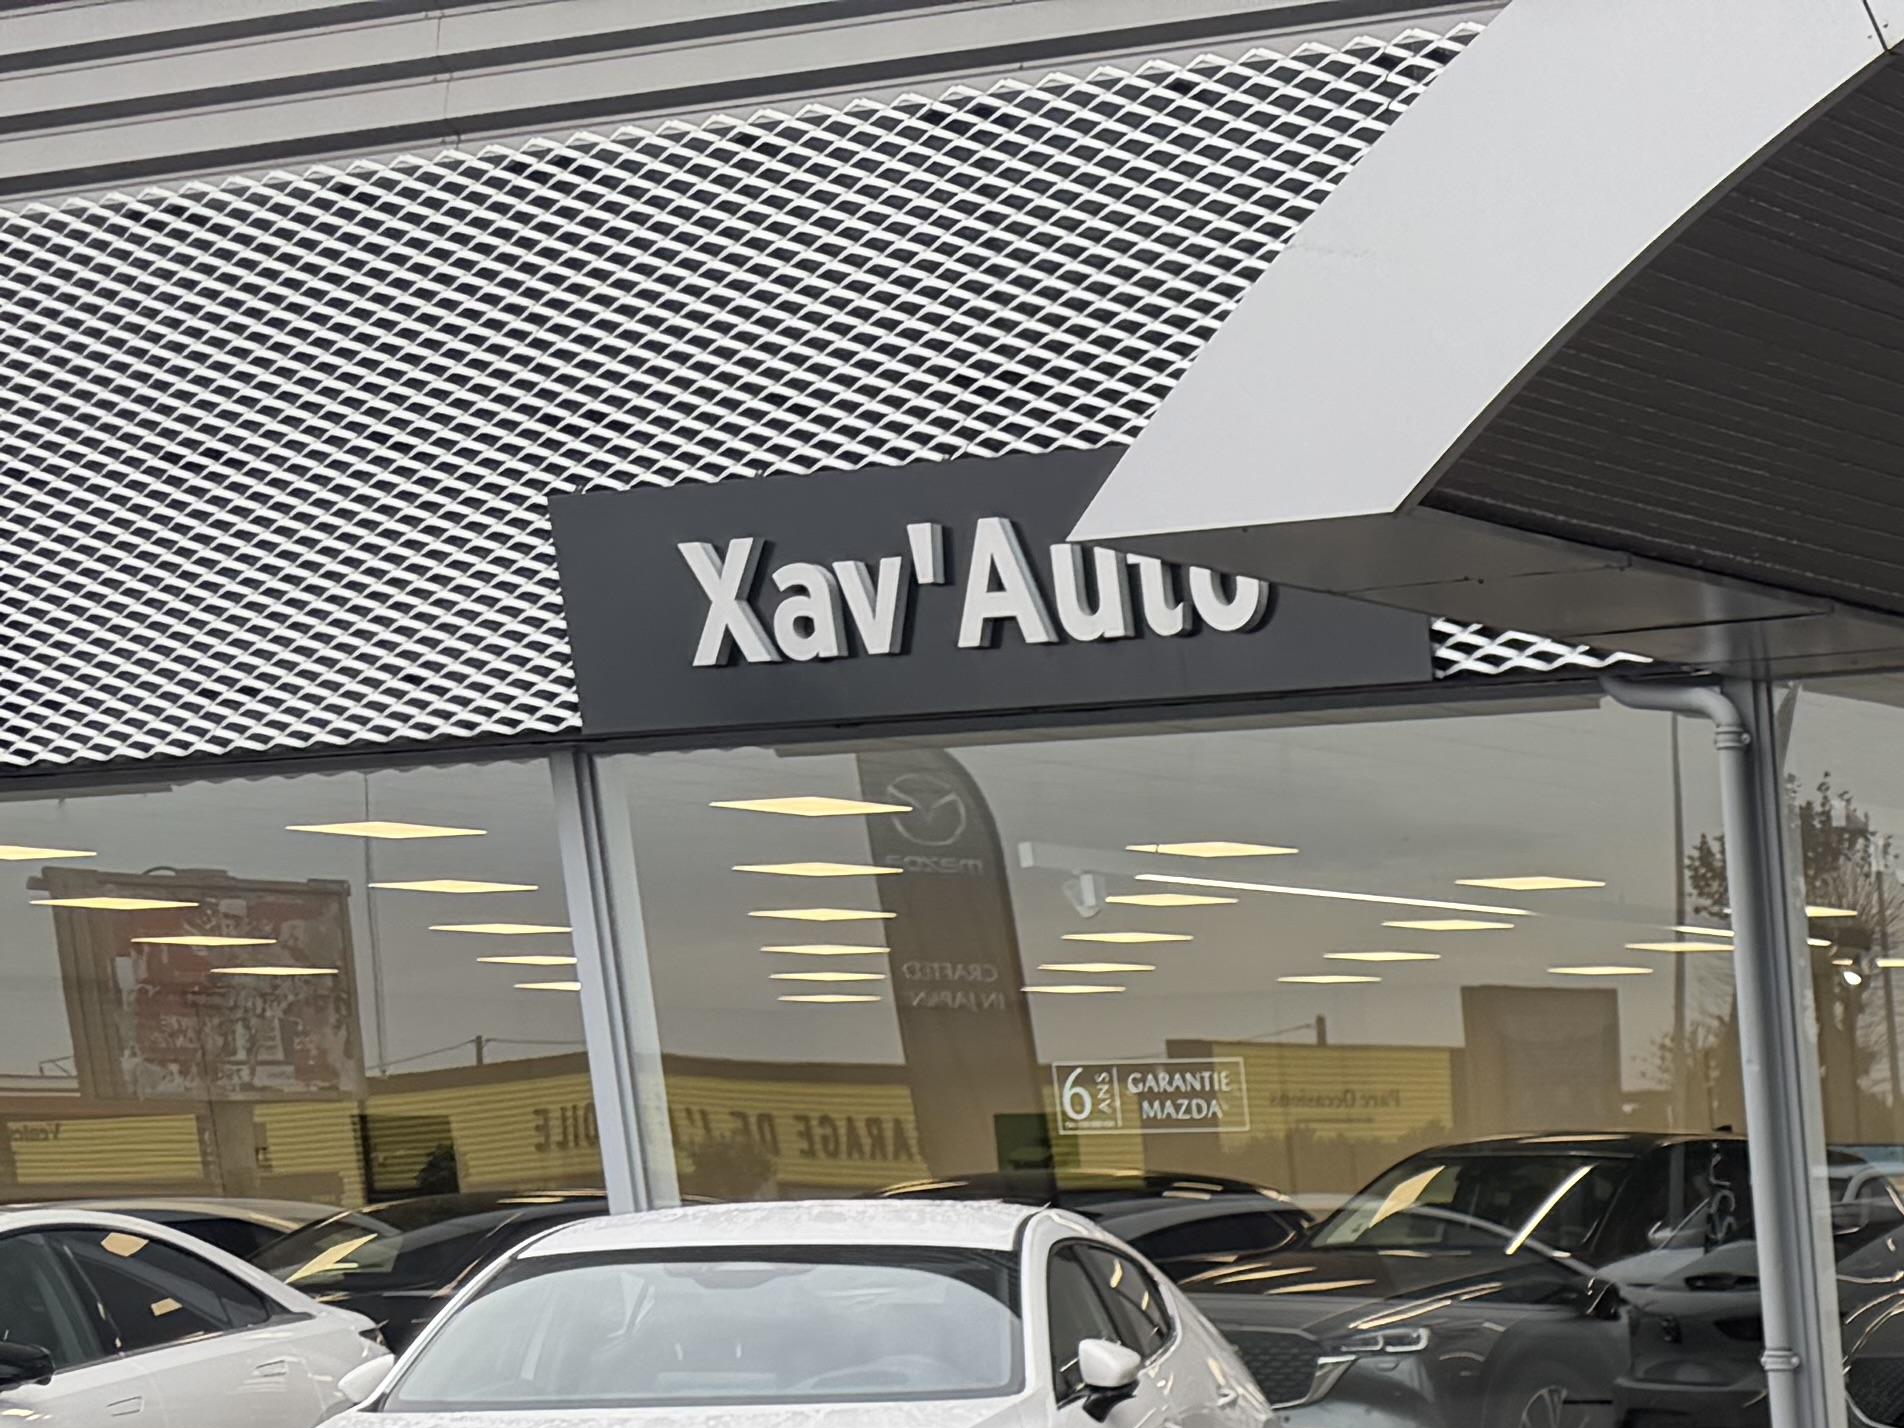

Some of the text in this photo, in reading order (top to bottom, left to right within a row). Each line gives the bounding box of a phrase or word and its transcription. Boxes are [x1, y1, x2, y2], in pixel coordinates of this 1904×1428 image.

[677, 515, 1278, 670] Xav'Auto
[1062, 1066, 1093, 1121] 6
[1126, 1070, 1233, 1094] GARANTIE
[1141, 1097, 1224, 1121] MAZDA
